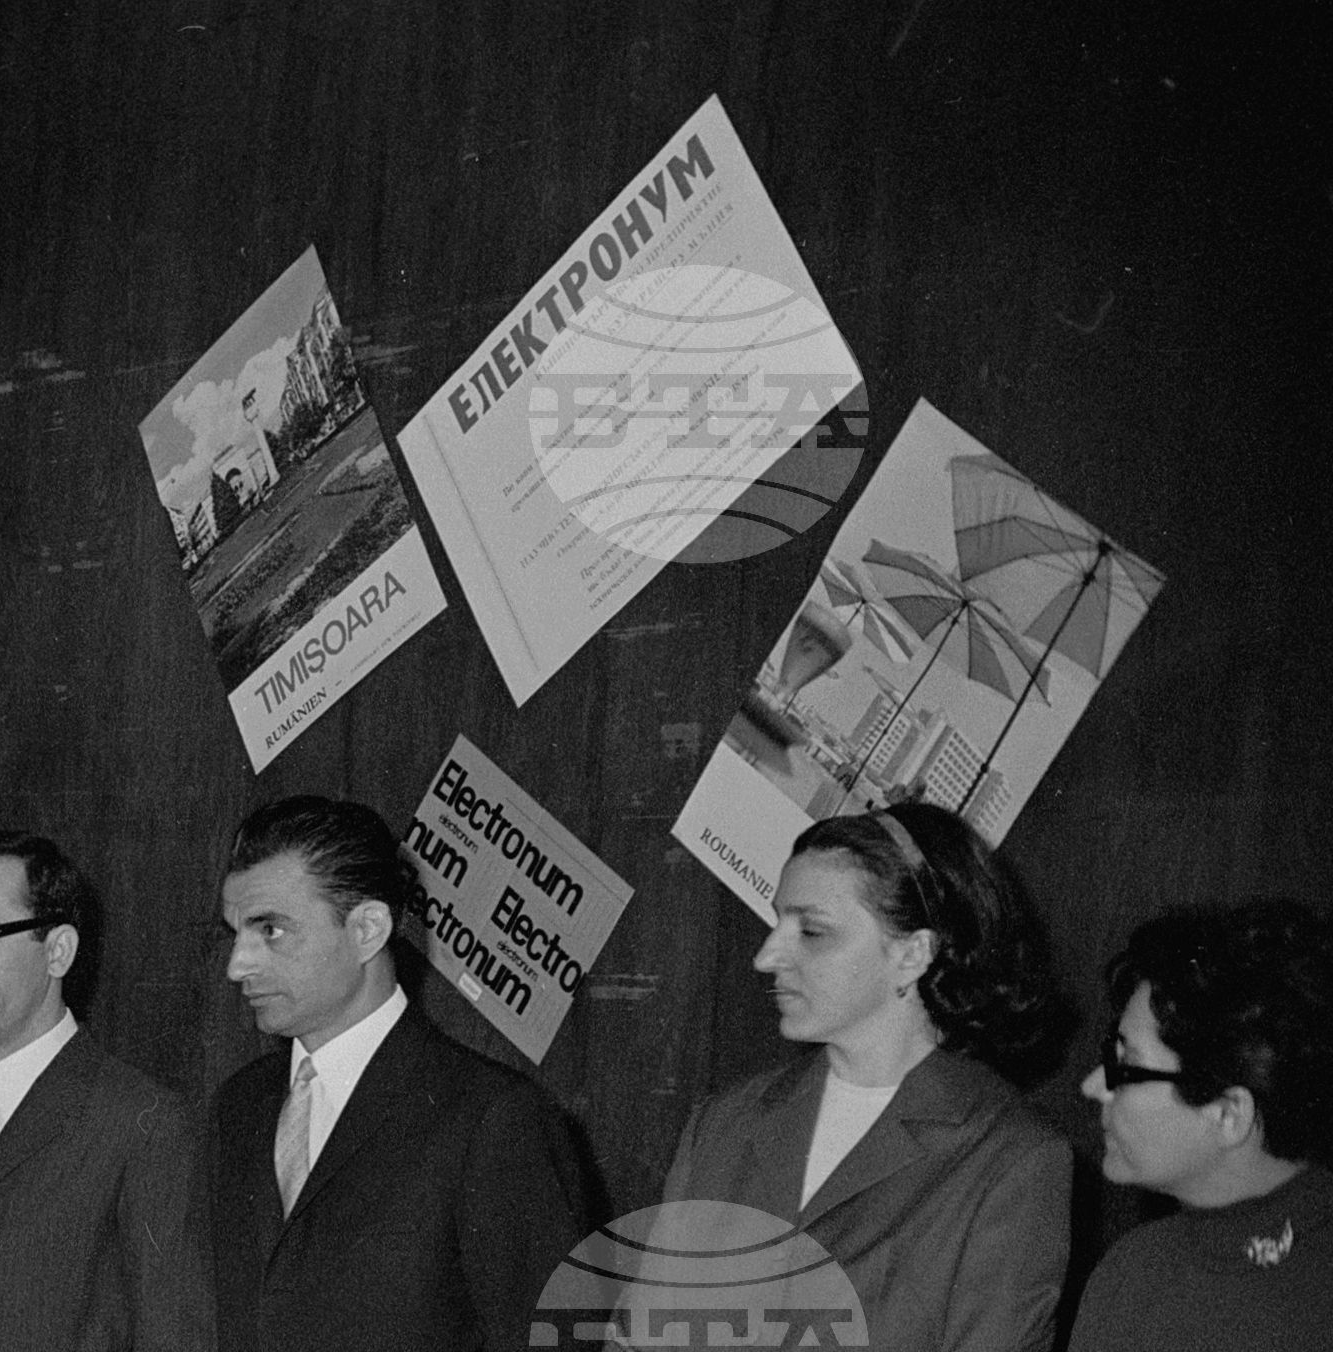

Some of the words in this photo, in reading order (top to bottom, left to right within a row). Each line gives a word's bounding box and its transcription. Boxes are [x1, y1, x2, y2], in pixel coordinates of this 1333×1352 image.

[446, 133, 716, 434] ЕЛЕКТРОНУМ
[264, 687, 328, 749] RUMÄNIEN
[404, 818, 468, 887] num
[490, 885, 583, 995] Electro
[433, 759, 584, 915] Electronum
[699, 827, 774, 900] ROUMANIE
[415, 884, 532, 1015] ectronum
